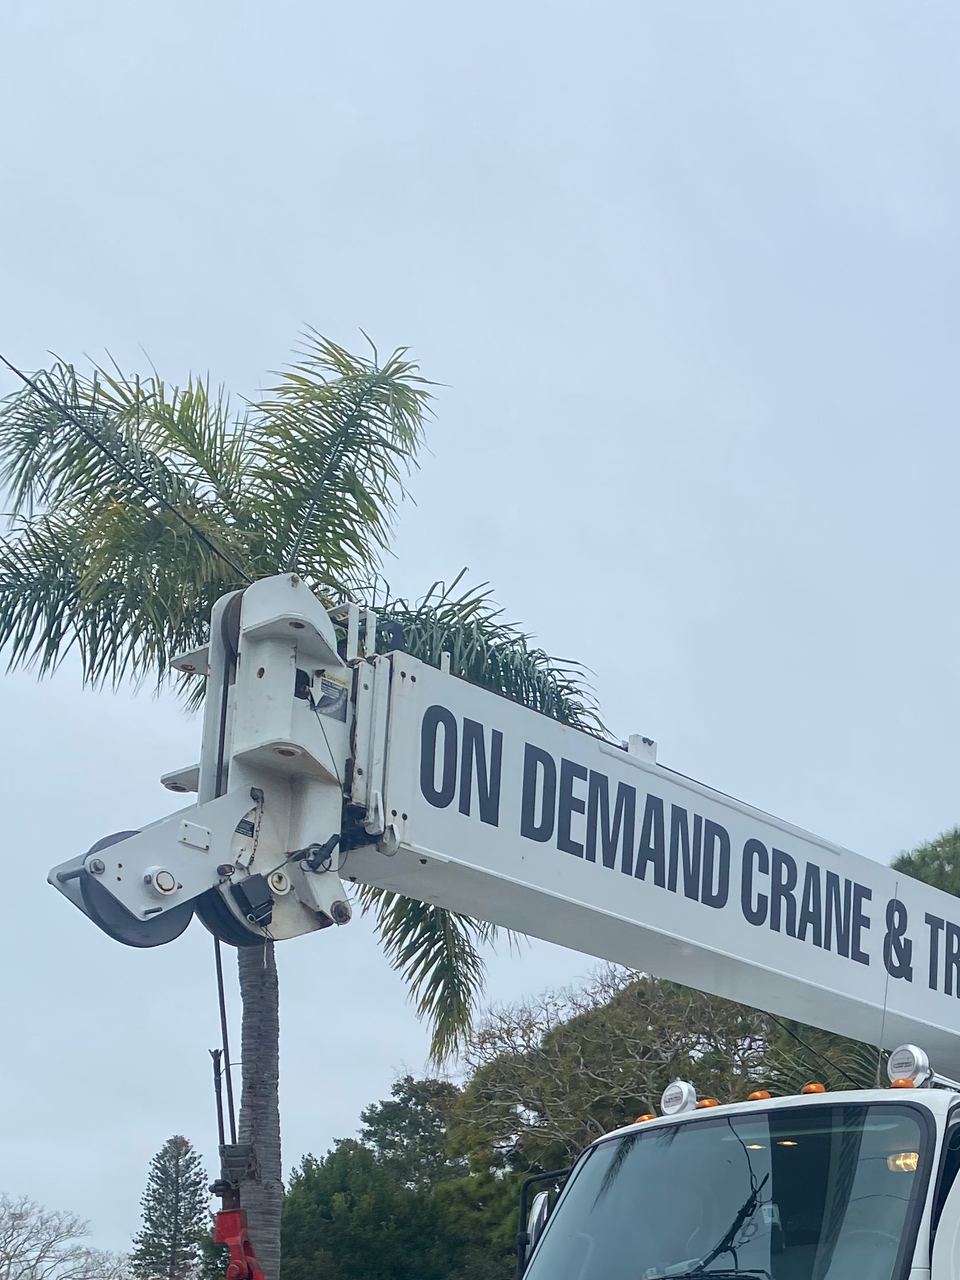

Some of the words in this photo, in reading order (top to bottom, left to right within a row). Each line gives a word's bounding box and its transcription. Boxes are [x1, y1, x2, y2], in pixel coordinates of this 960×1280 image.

[420, 705, 503, 827] ON
[520, 742, 730, 909] DEMAND
[741, 838, 872, 966] CRANE
[883, 899, 913, 983] &
